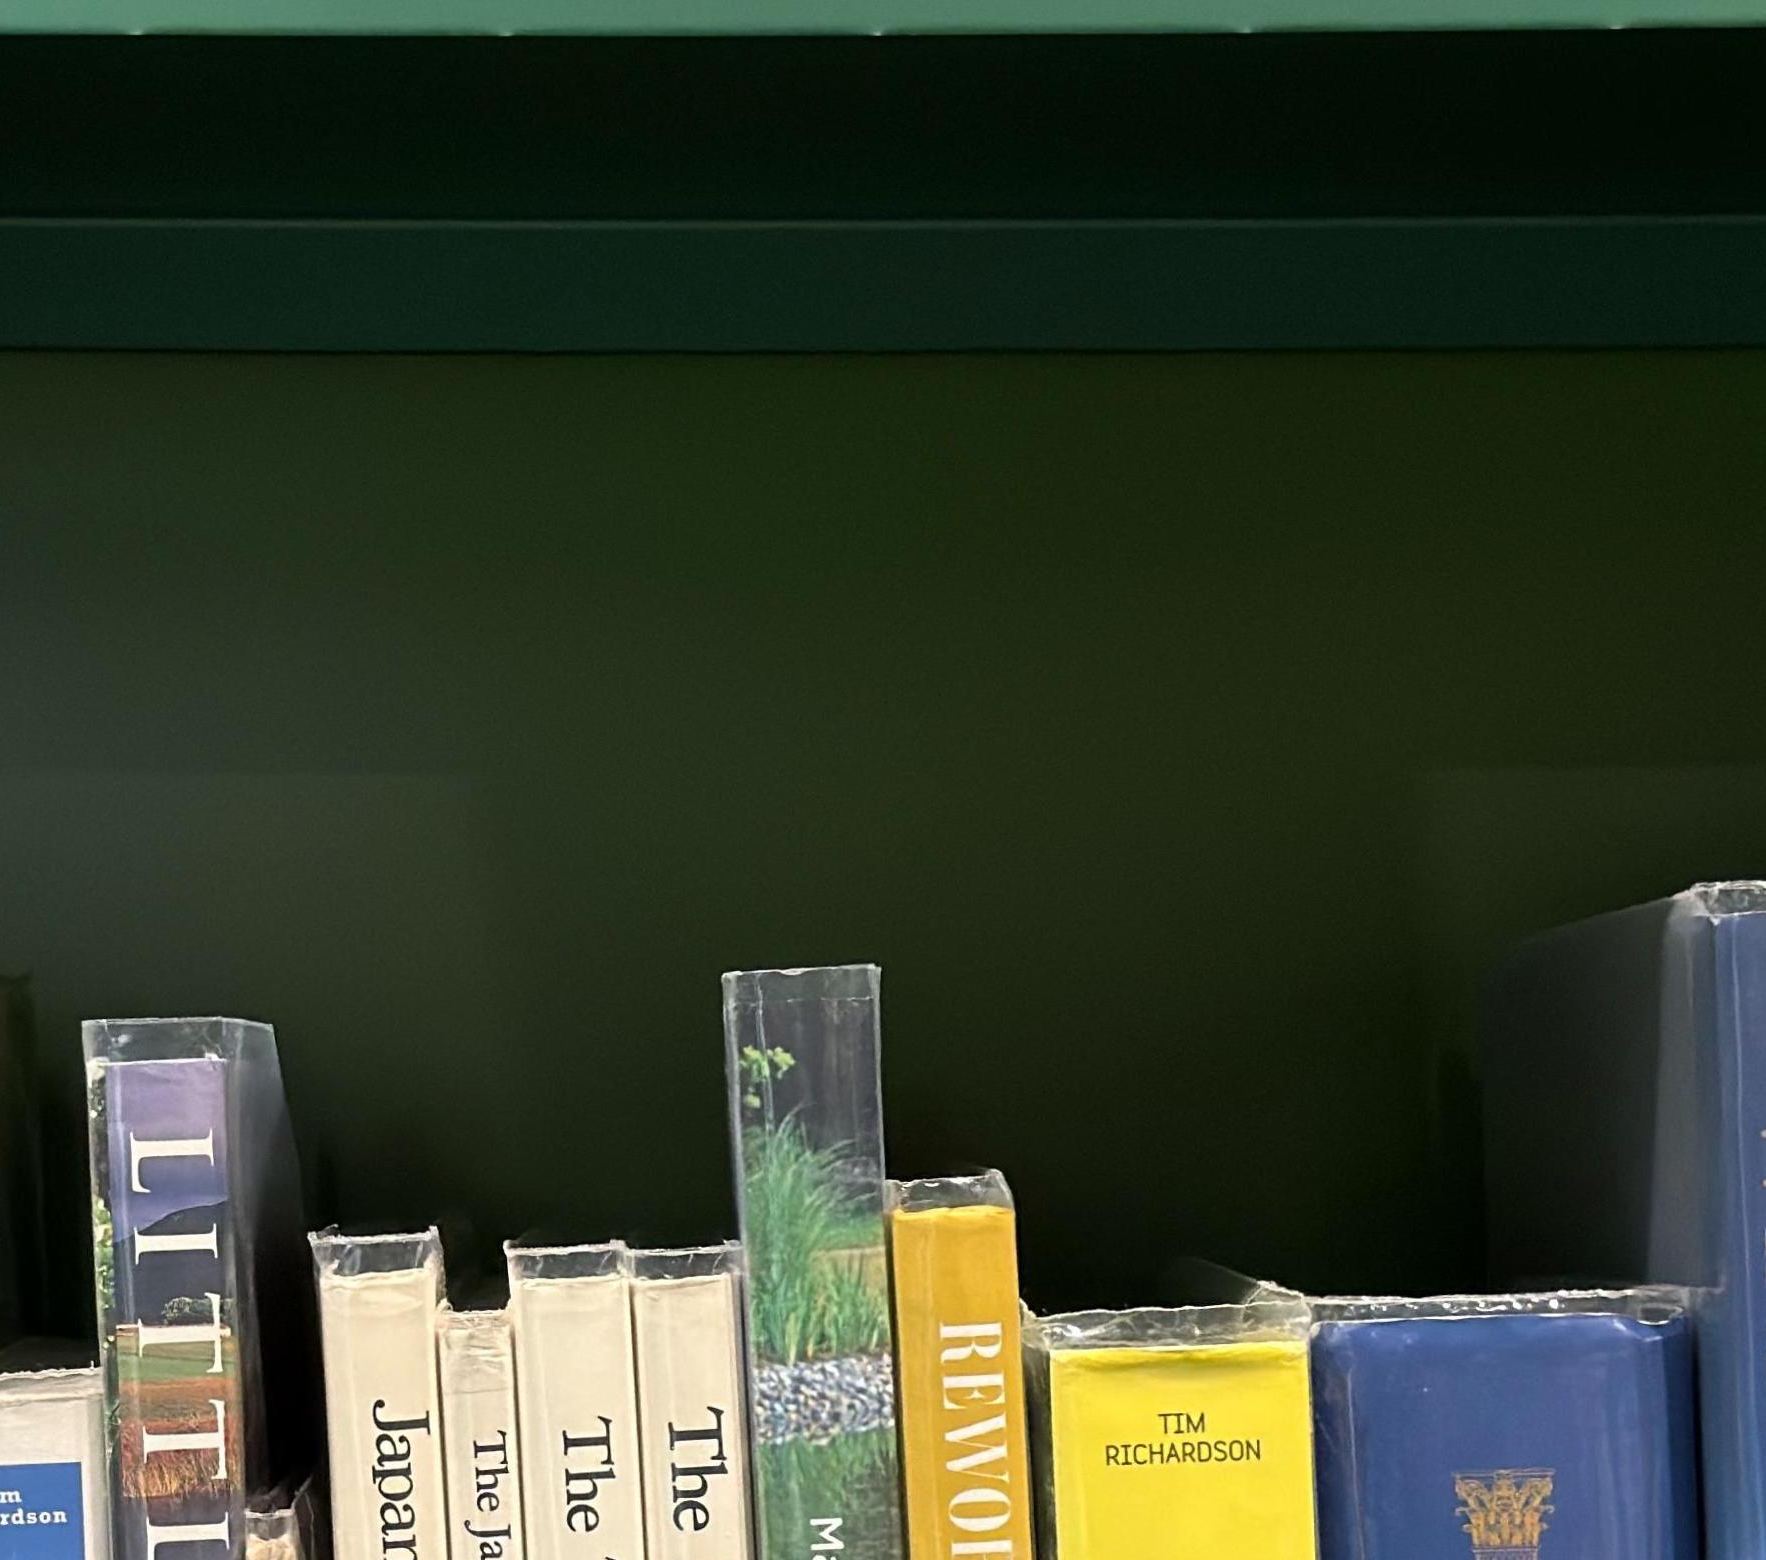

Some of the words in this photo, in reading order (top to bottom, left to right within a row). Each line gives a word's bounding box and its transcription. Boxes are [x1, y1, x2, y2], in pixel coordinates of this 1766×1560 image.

[1105, 1439, 1262, 1467] RICHARDSON
[1157, 1412, 1206, 1435] TIM
[472, 1429, 509, 1513] The
[562, 1415, 617, 1533] The
[668, 1405, 729, 1532] The
